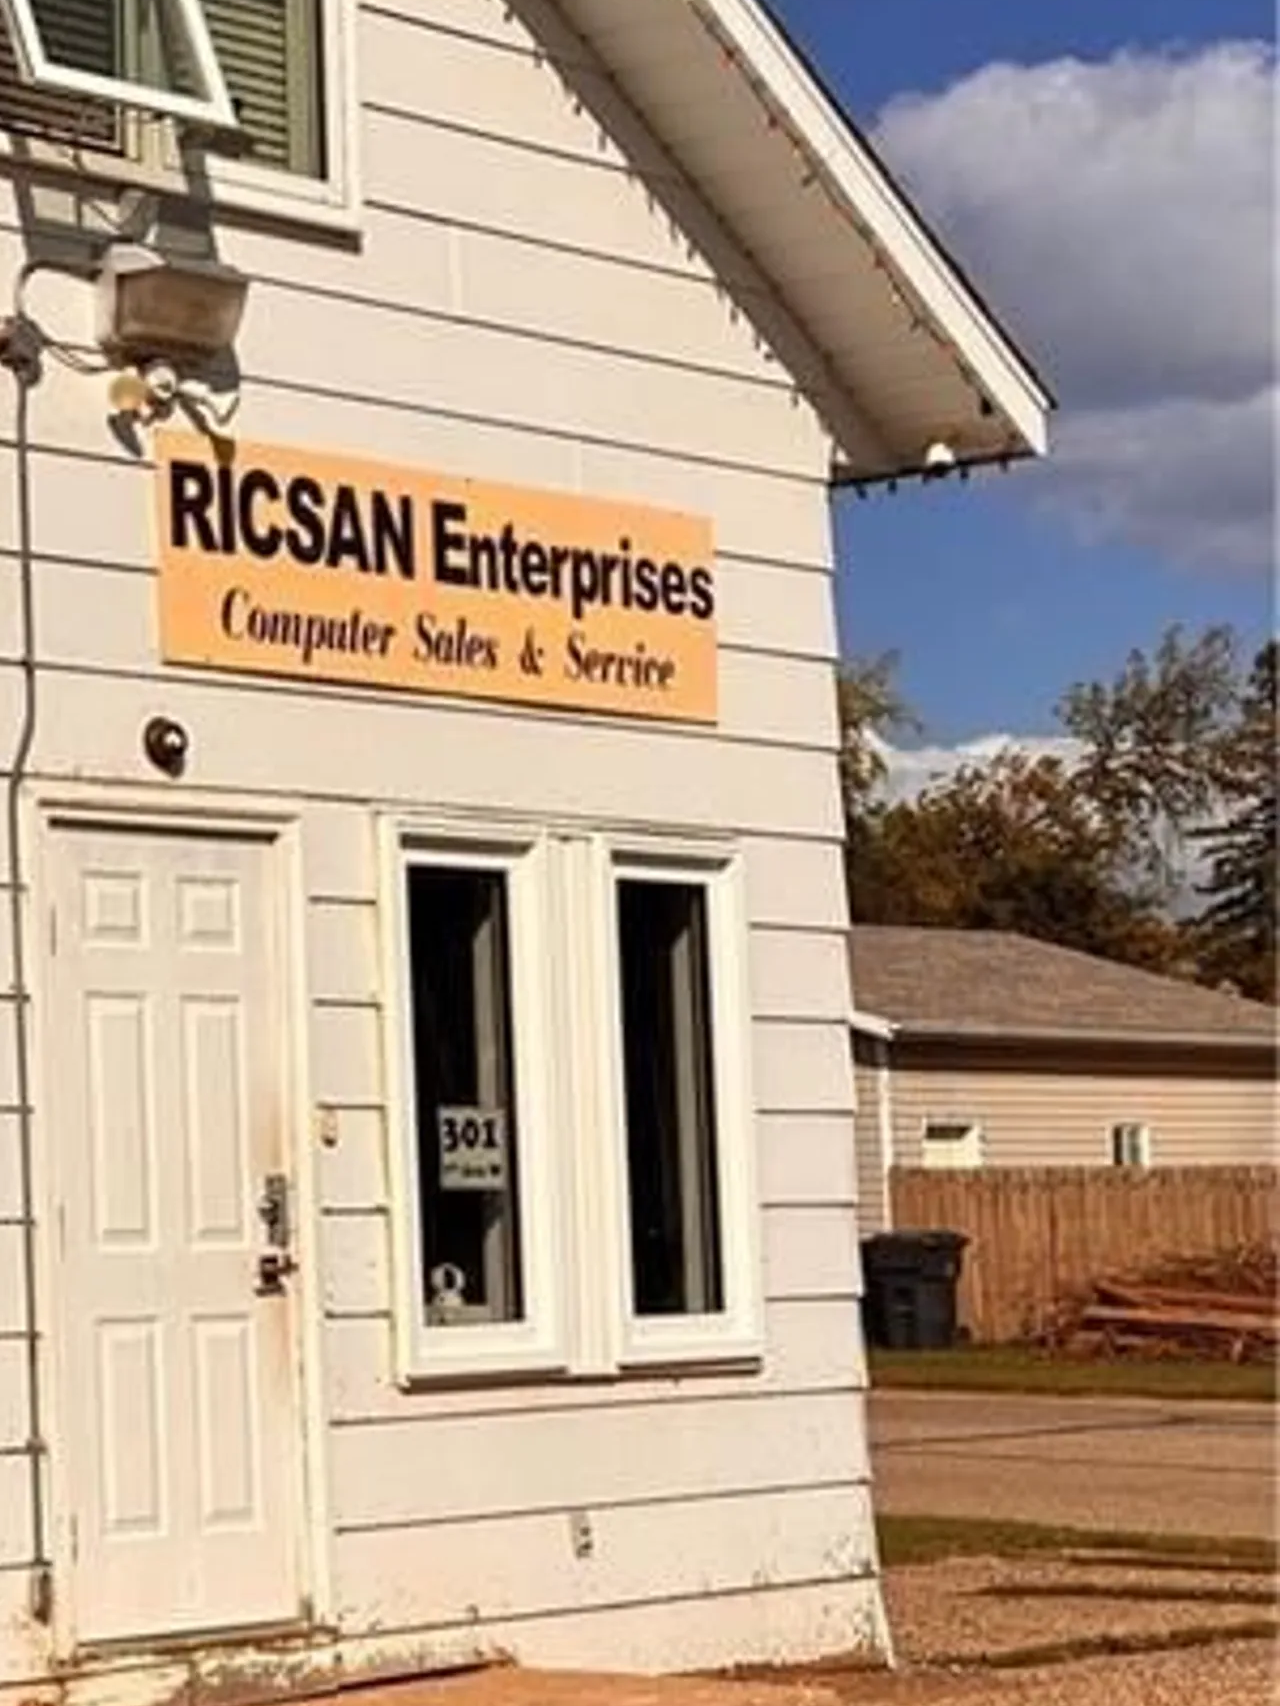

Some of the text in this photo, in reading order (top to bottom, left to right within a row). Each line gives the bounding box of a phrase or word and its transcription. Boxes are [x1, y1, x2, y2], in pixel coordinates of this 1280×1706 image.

[171, 460, 715, 620] RICSAN Enterprises
[221, 587, 677, 689] Computer Sales & Service
[443, 1117, 498, 1152] 301
